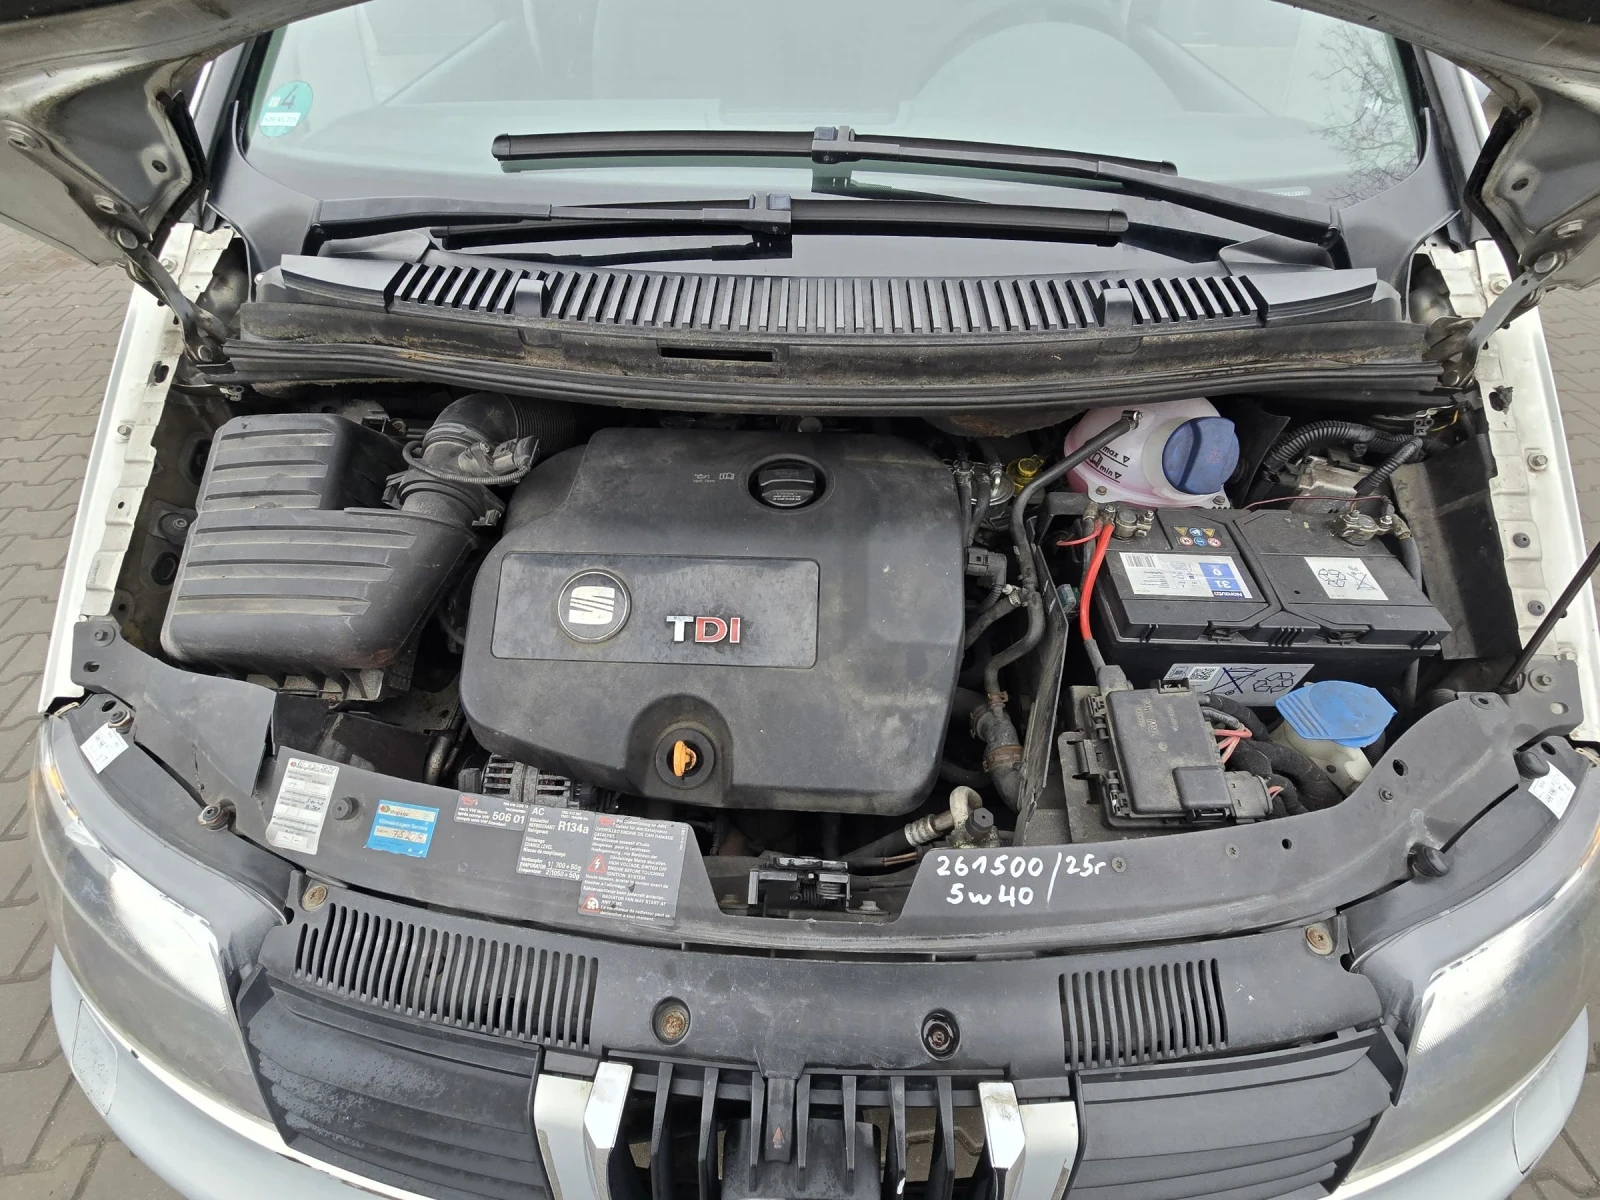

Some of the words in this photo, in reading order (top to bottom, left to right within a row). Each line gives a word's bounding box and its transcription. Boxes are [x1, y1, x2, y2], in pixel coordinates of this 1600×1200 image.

[280, 84, 299, 110] 4
[1102, 446, 1118, 458] max
[1100, 464, 1113, 476] min
[1214, 580, 1232, 588] 31
[666, 615, 741, 644] TDI
[492, 811, 512, 822] 506
[513, 814, 525, 824] 01
[532, 807, 545, 816] AC
[558, 821, 589, 834] R134a
[936, 854, 1044, 878] 261500
